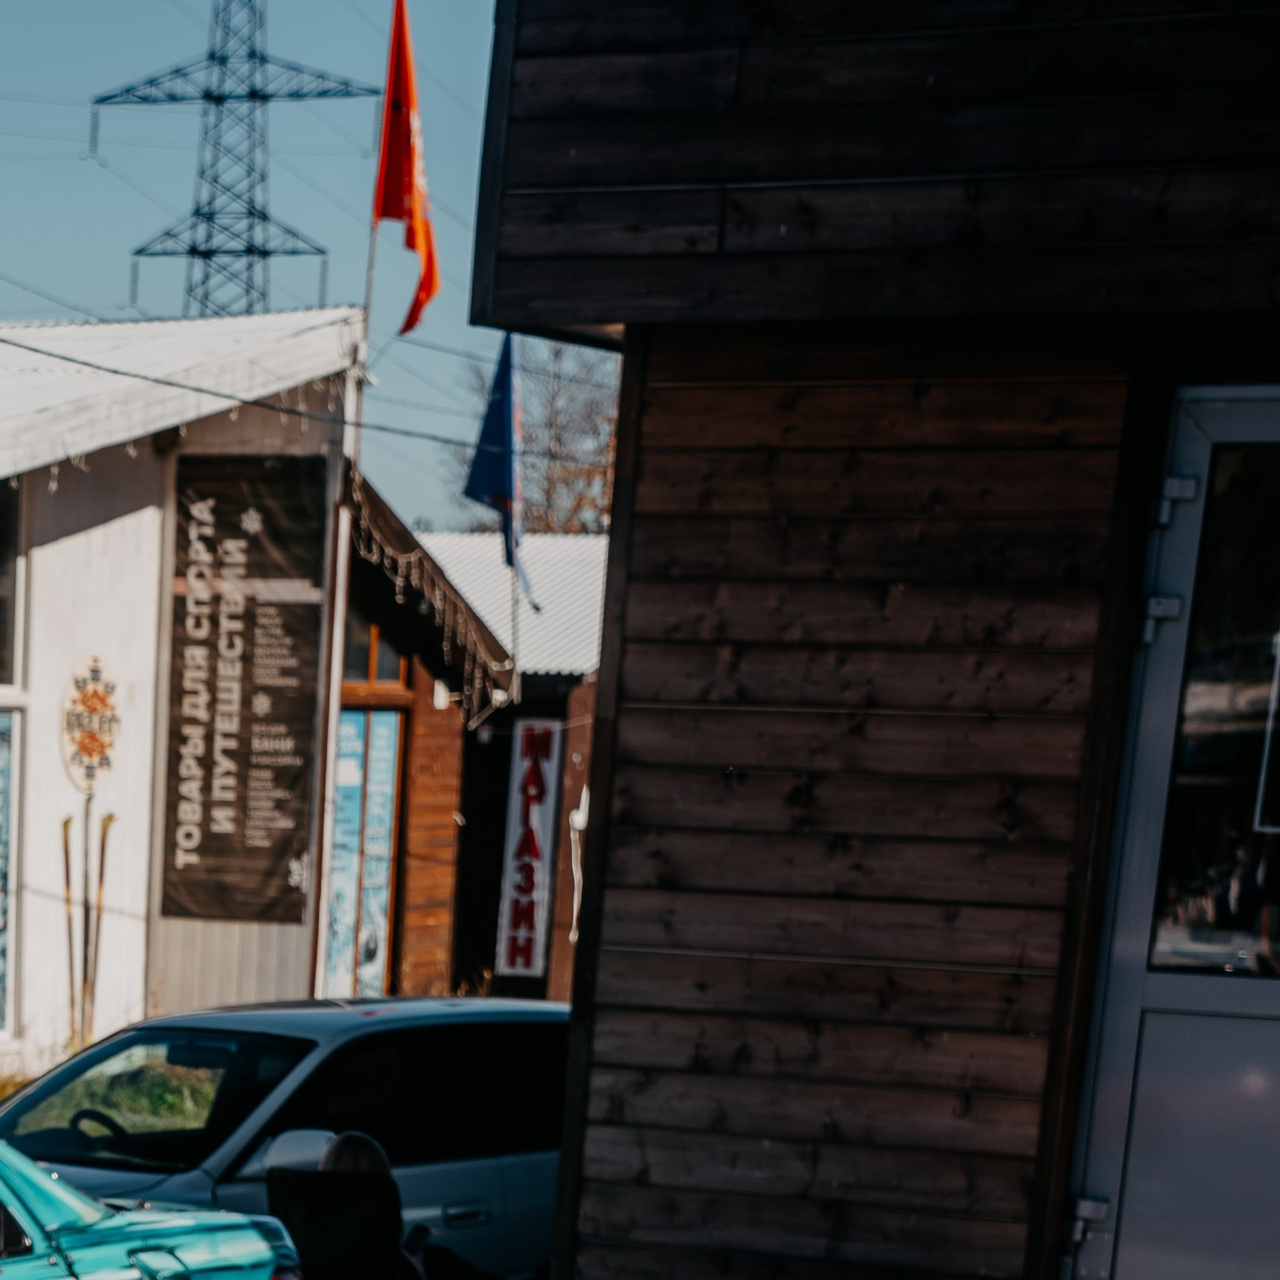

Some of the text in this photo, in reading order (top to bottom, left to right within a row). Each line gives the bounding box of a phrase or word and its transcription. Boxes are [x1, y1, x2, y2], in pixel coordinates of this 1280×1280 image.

[175, 498, 216, 868] ТОВАРЫ ДЛЯ СПОРТА
[210, 538, 248, 833] И ПУТЕШЕСТВИЙ
[506, 726, 553, 968] МАГАЗИН
